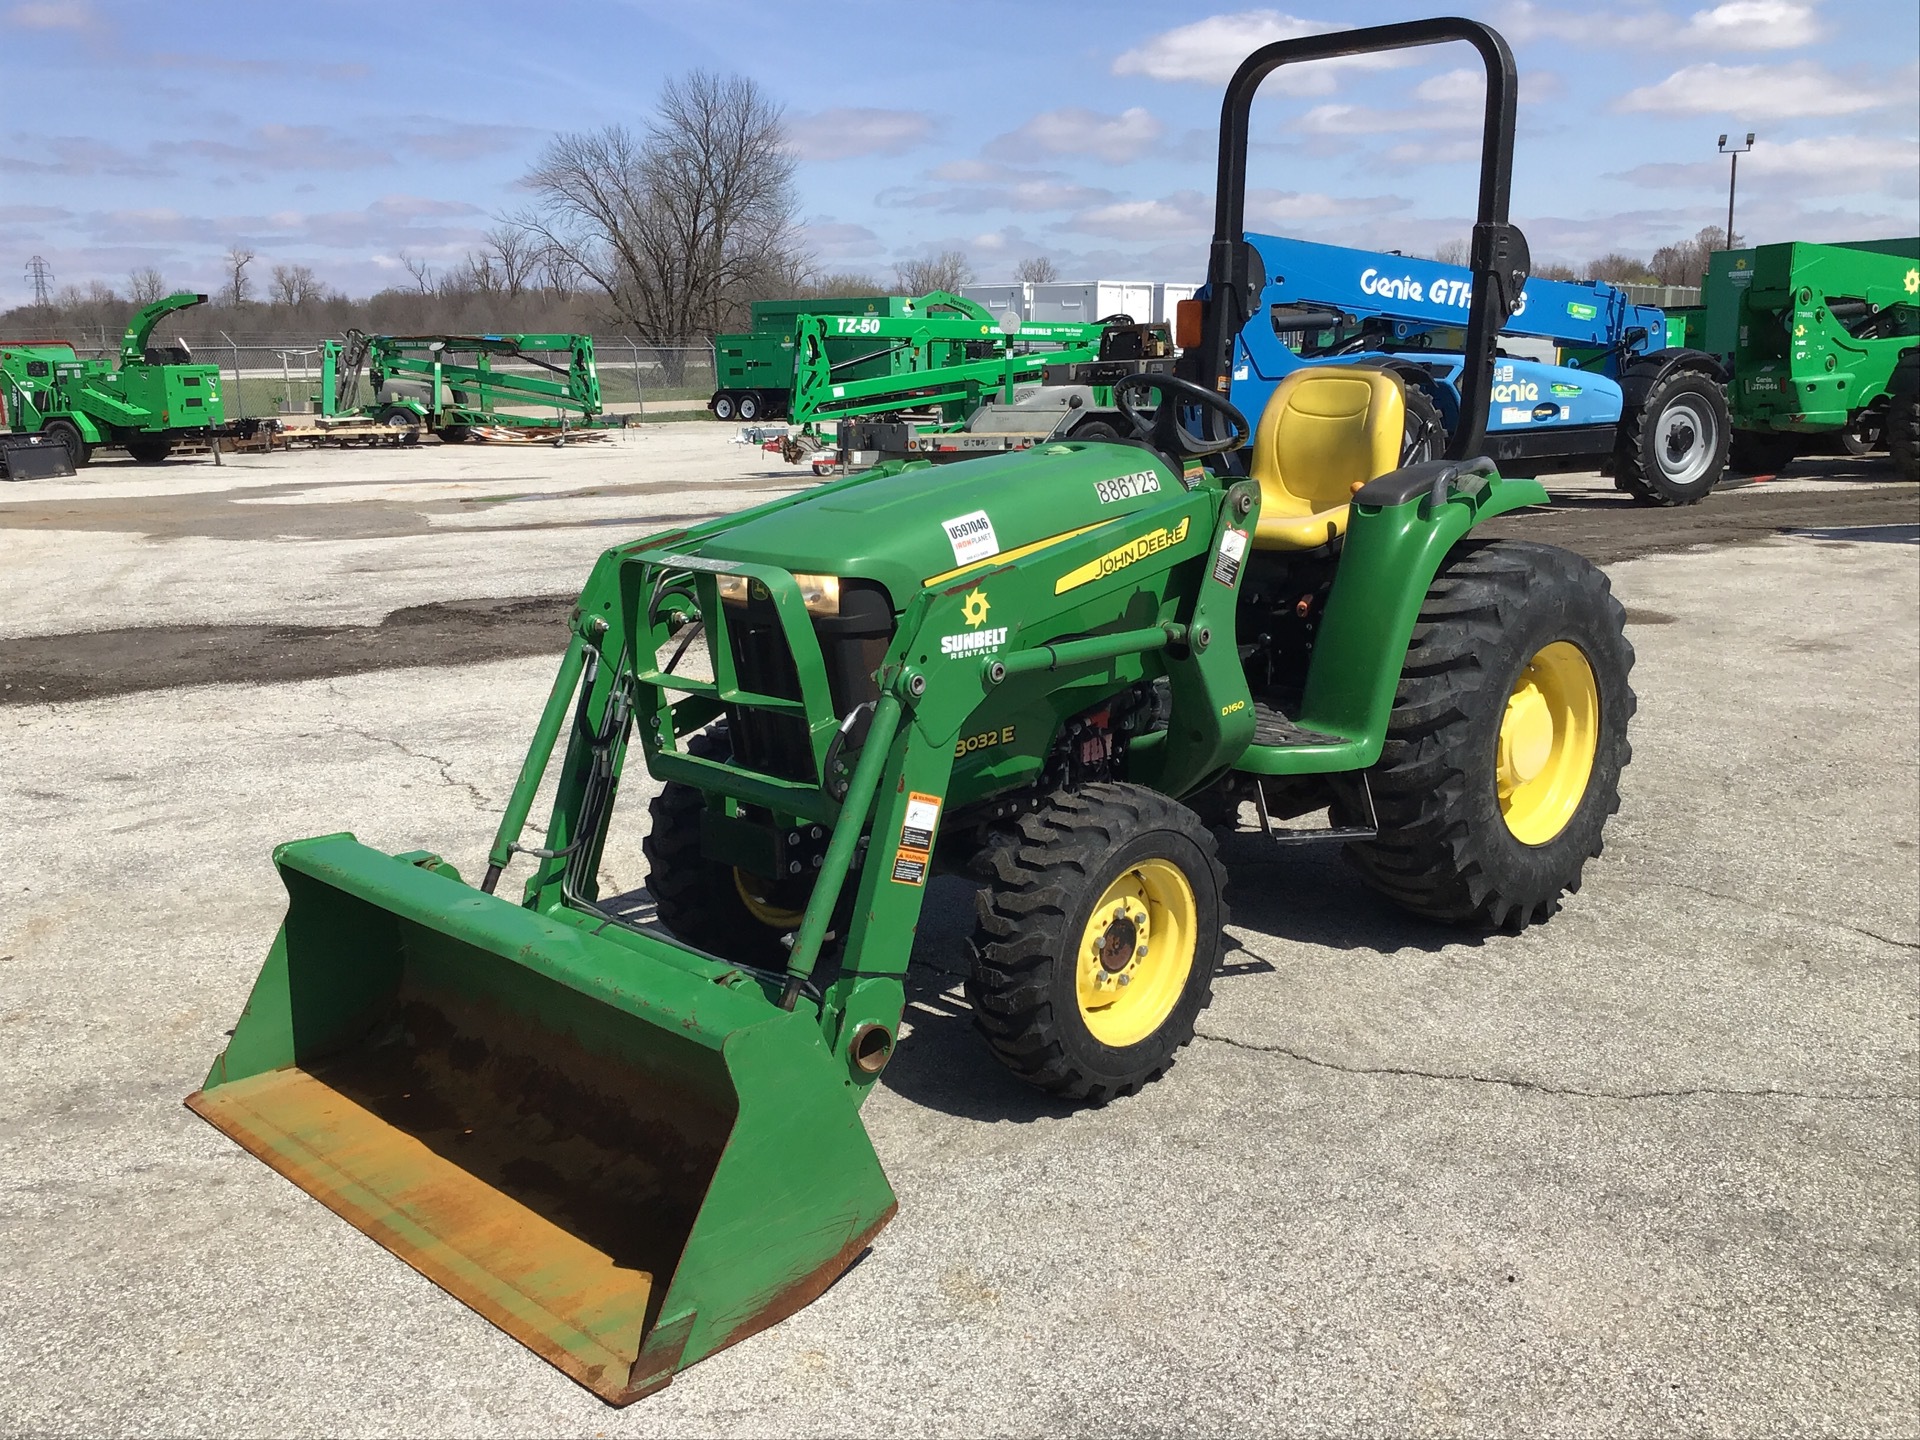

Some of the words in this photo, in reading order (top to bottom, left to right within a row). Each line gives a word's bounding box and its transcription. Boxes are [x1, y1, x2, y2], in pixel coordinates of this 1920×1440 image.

[1360, 268, 1425, 302] Genie
[950, 297, 973, 312] Vermeer
[837, 318, 880, 334] TZ-50
[1021, 326, 1052, 336] RENTALS
[1491, 378, 1538, 402] enie
[1096, 471, 1159, 503] 886125
[949, 517, 989, 540] U597046
[1095, 547, 1134, 578] JOHN
[941, 627, 1008, 654] SUNBELT
[950, 646, 998, 660] RENTALS
[1222, 701, 1245, 716] D160
[955, 731, 998, 757] 3032
[1002, 725, 1016, 743] E
